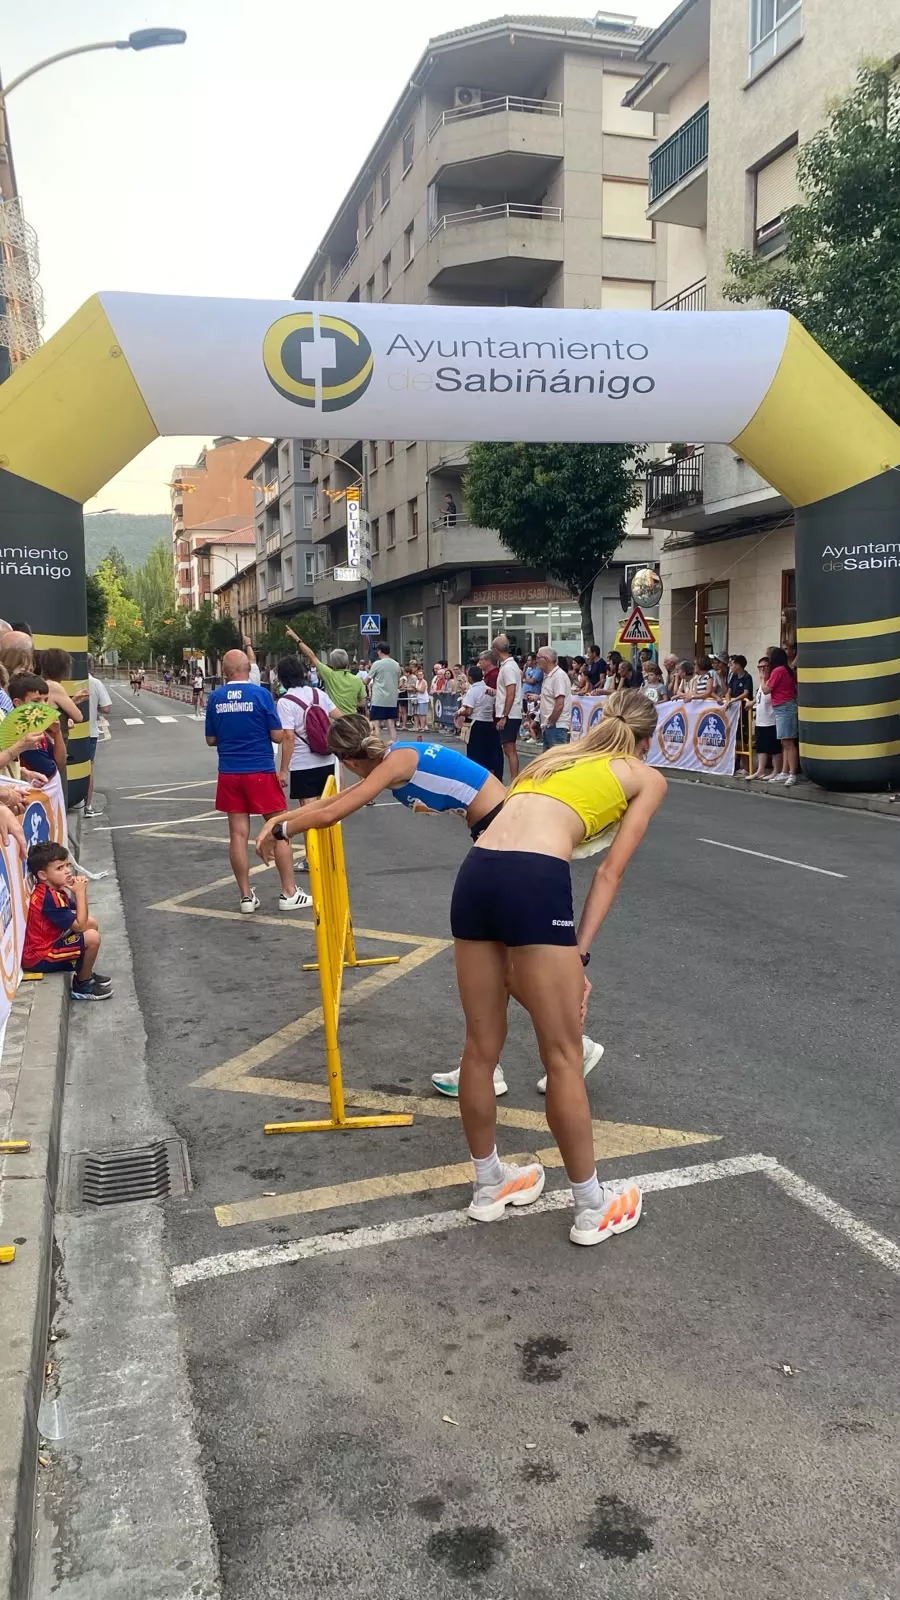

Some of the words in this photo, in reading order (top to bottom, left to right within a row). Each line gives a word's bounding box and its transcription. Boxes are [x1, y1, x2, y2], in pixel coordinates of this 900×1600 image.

[386, 333, 649, 362] Ayuntamiento
[348, 502, 360, 567] OLIMPIC
[473, 591, 497, 602] BAZAR
[498, 590, 527, 601] REGALO
[227, 689, 242, 700] GMS
